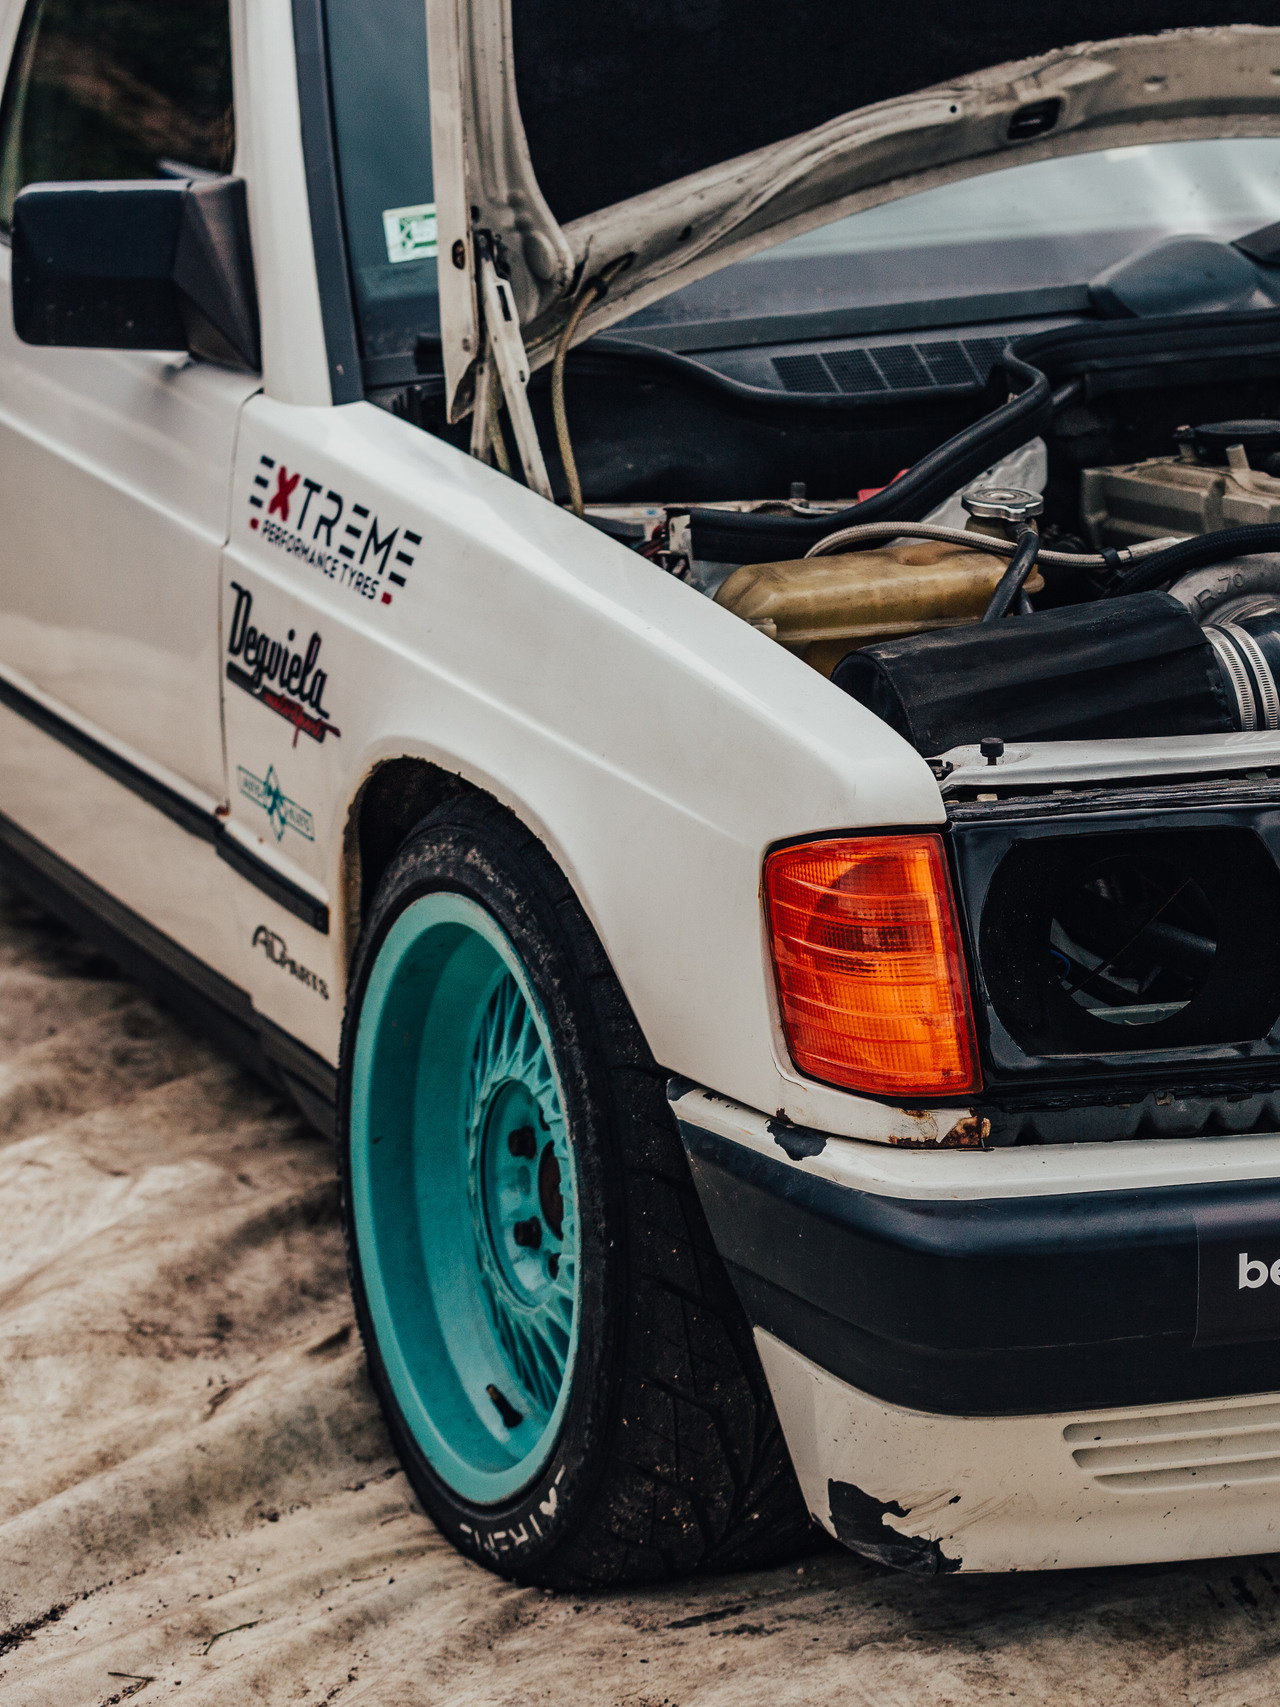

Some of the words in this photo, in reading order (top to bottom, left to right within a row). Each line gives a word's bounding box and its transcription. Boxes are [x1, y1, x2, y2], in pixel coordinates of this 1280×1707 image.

[249, 455, 423, 588] EXTREME
[262, 520, 339, 579] PERFORMANCE
[340, 563, 380, 600] TYRES
[228, 581, 330, 720] Degviela
